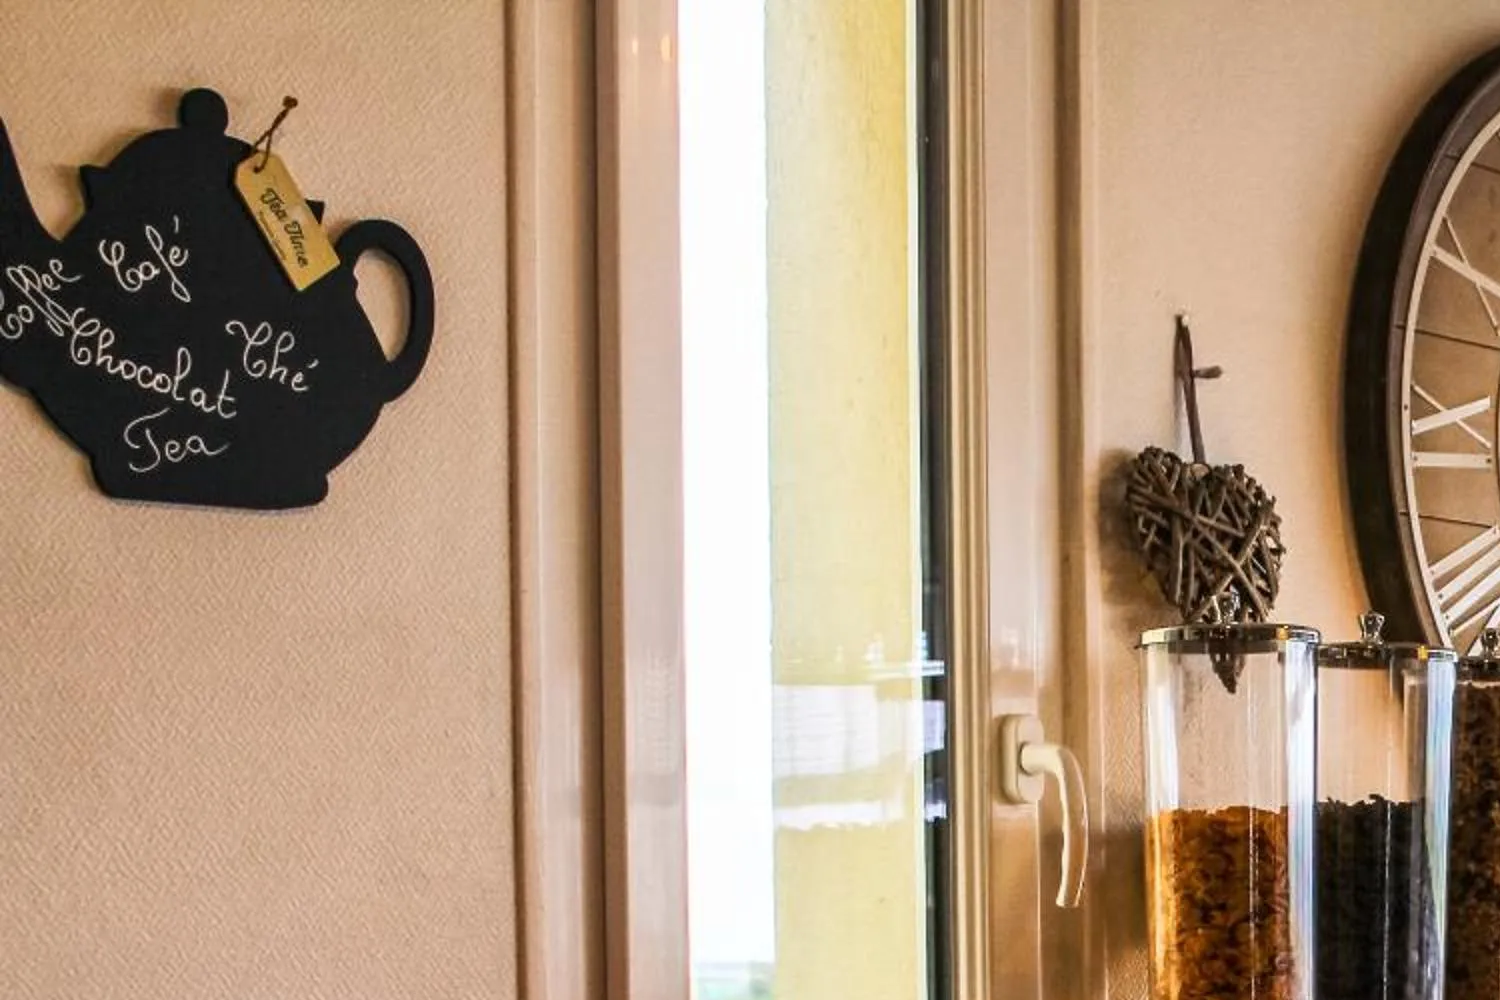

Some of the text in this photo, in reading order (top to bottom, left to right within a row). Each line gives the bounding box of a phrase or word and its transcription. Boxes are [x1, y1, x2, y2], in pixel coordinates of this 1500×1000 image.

[99, 215, 191, 302] Café
[70, 307, 238, 418] Chocolat
[225, 320, 320, 393] Thé
[123, 407, 230, 473] Tea
